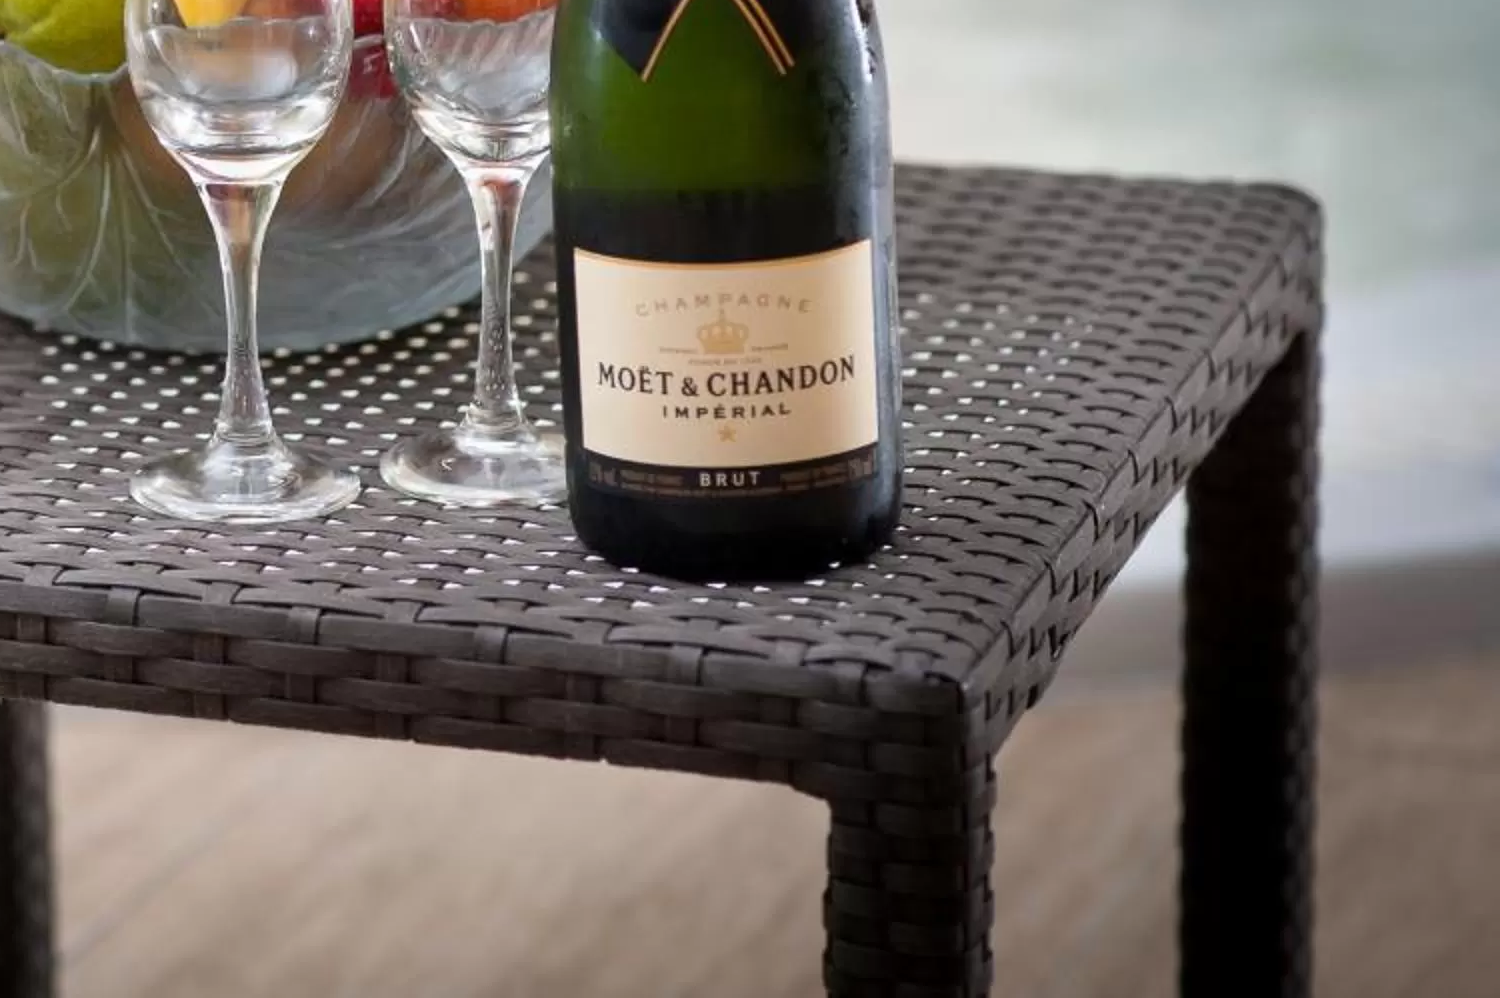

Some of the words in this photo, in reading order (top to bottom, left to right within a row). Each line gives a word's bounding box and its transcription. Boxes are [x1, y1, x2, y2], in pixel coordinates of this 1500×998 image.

[635, 293, 813, 316] CHAMPAGNE
[598, 361, 673, 396] MOËT
[681, 378, 699, 397] &
[707, 355, 856, 396] CHANDON
[662, 403, 793, 420] IMPÉRIAL
[699, 471, 761, 488] BRUT
